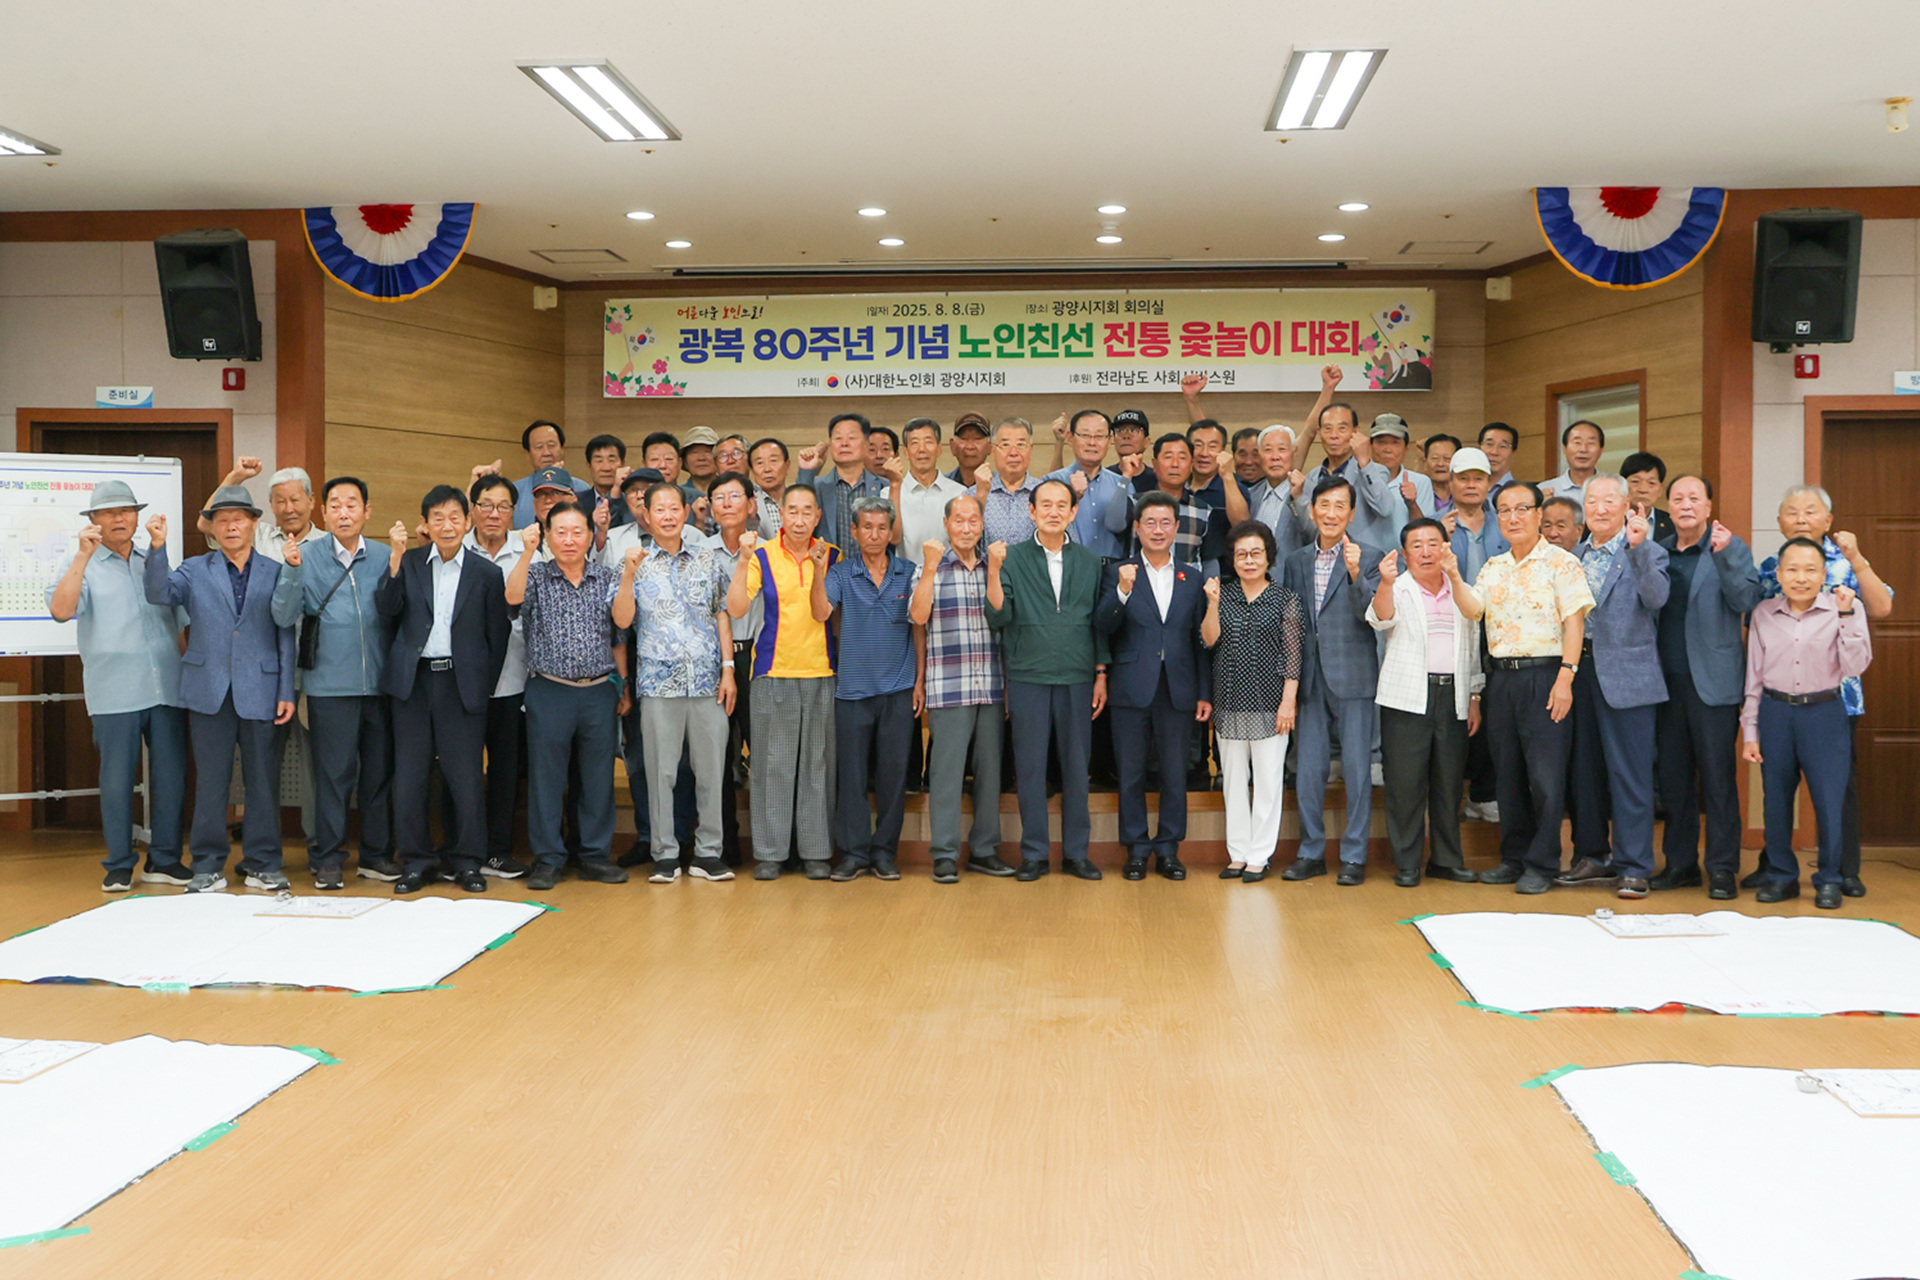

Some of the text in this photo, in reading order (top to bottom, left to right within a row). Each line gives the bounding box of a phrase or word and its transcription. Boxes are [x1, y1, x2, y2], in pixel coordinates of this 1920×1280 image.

[893, 304, 931, 316] 2025.
[935, 303, 947, 316] 8.
[952, 303, 985, 316] 8.(금)
[1052, 300, 1119, 316] 광양시지회
[1124, 300, 1164, 315] 회의실
[679, 320, 1359, 364] 광복 80주년 기념 노인친선 전통 윷놀이 대회
[844, 373, 936, 389] (사)대한노인회
[940, 372, 1006, 388] 광양시지회
[1096, 370, 1149, 386] 전라남도
[108, 389, 139, 400] 준비실
